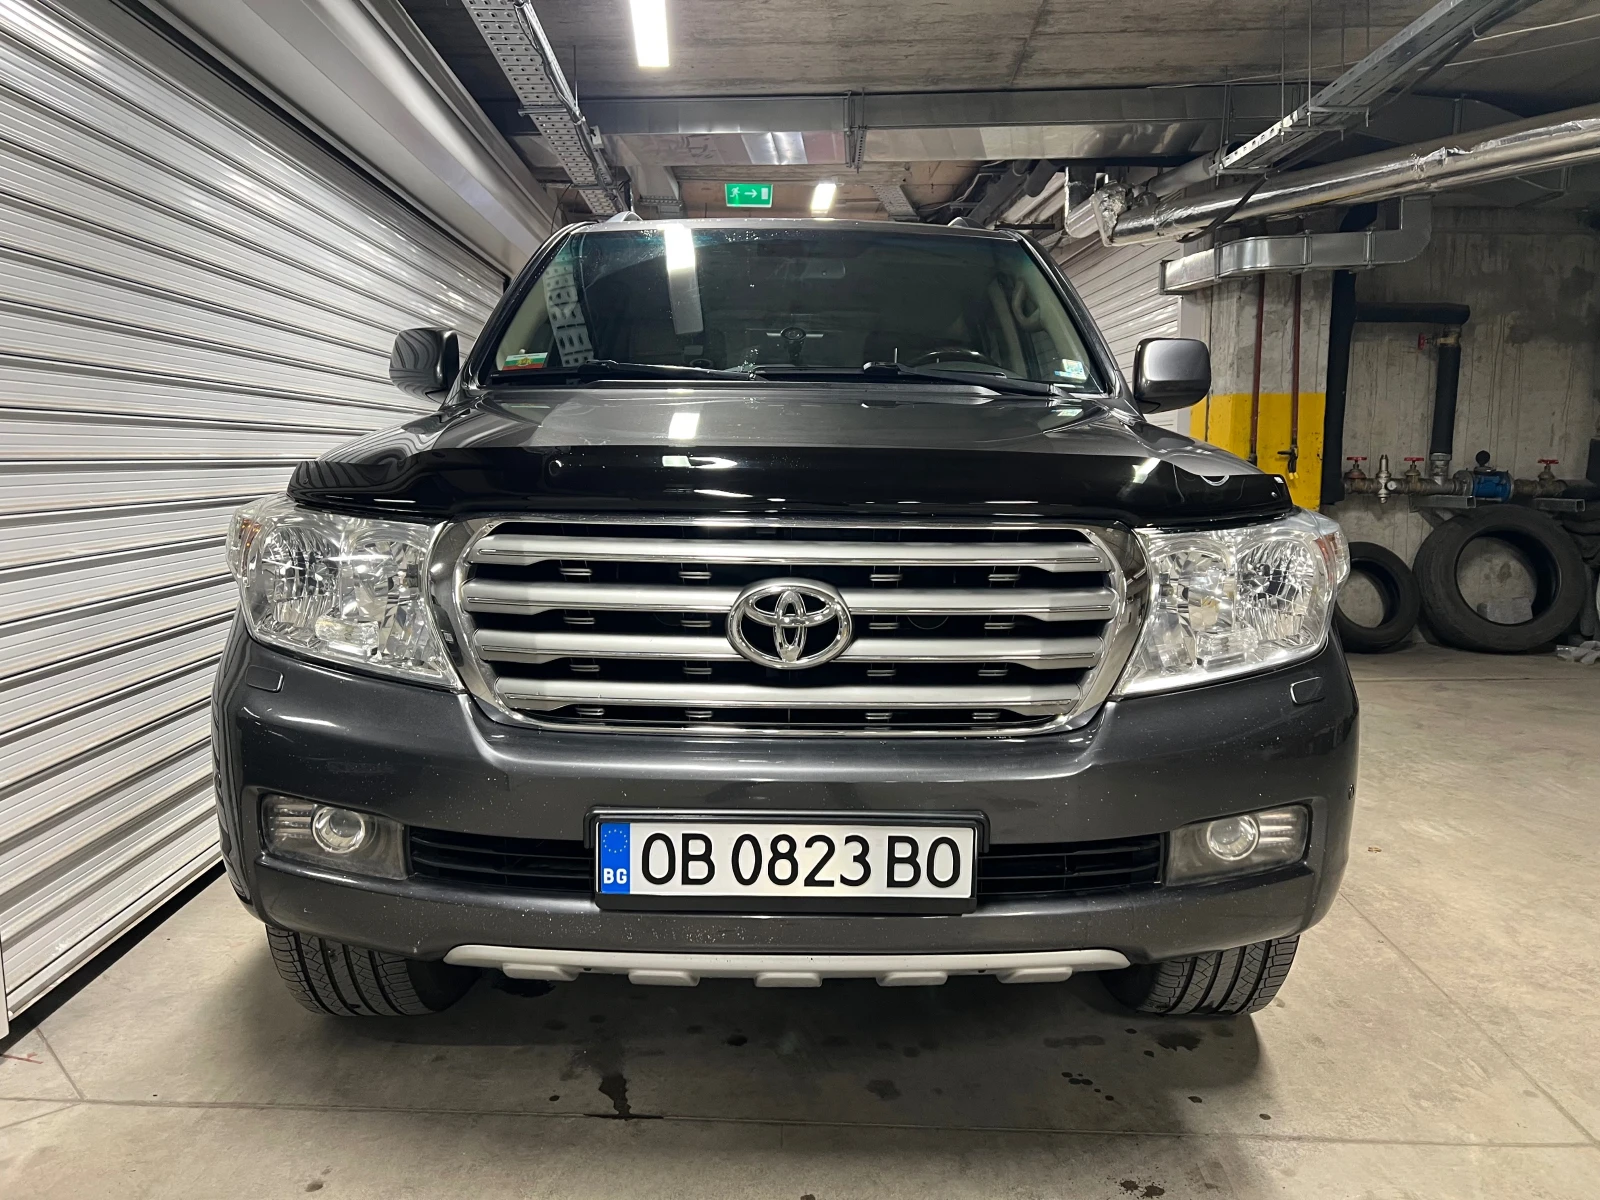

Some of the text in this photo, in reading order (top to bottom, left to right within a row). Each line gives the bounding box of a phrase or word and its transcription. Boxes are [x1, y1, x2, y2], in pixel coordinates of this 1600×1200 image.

[603, 868, 628, 885] BG
[641, 832, 962, 889] OB 0823 BO
